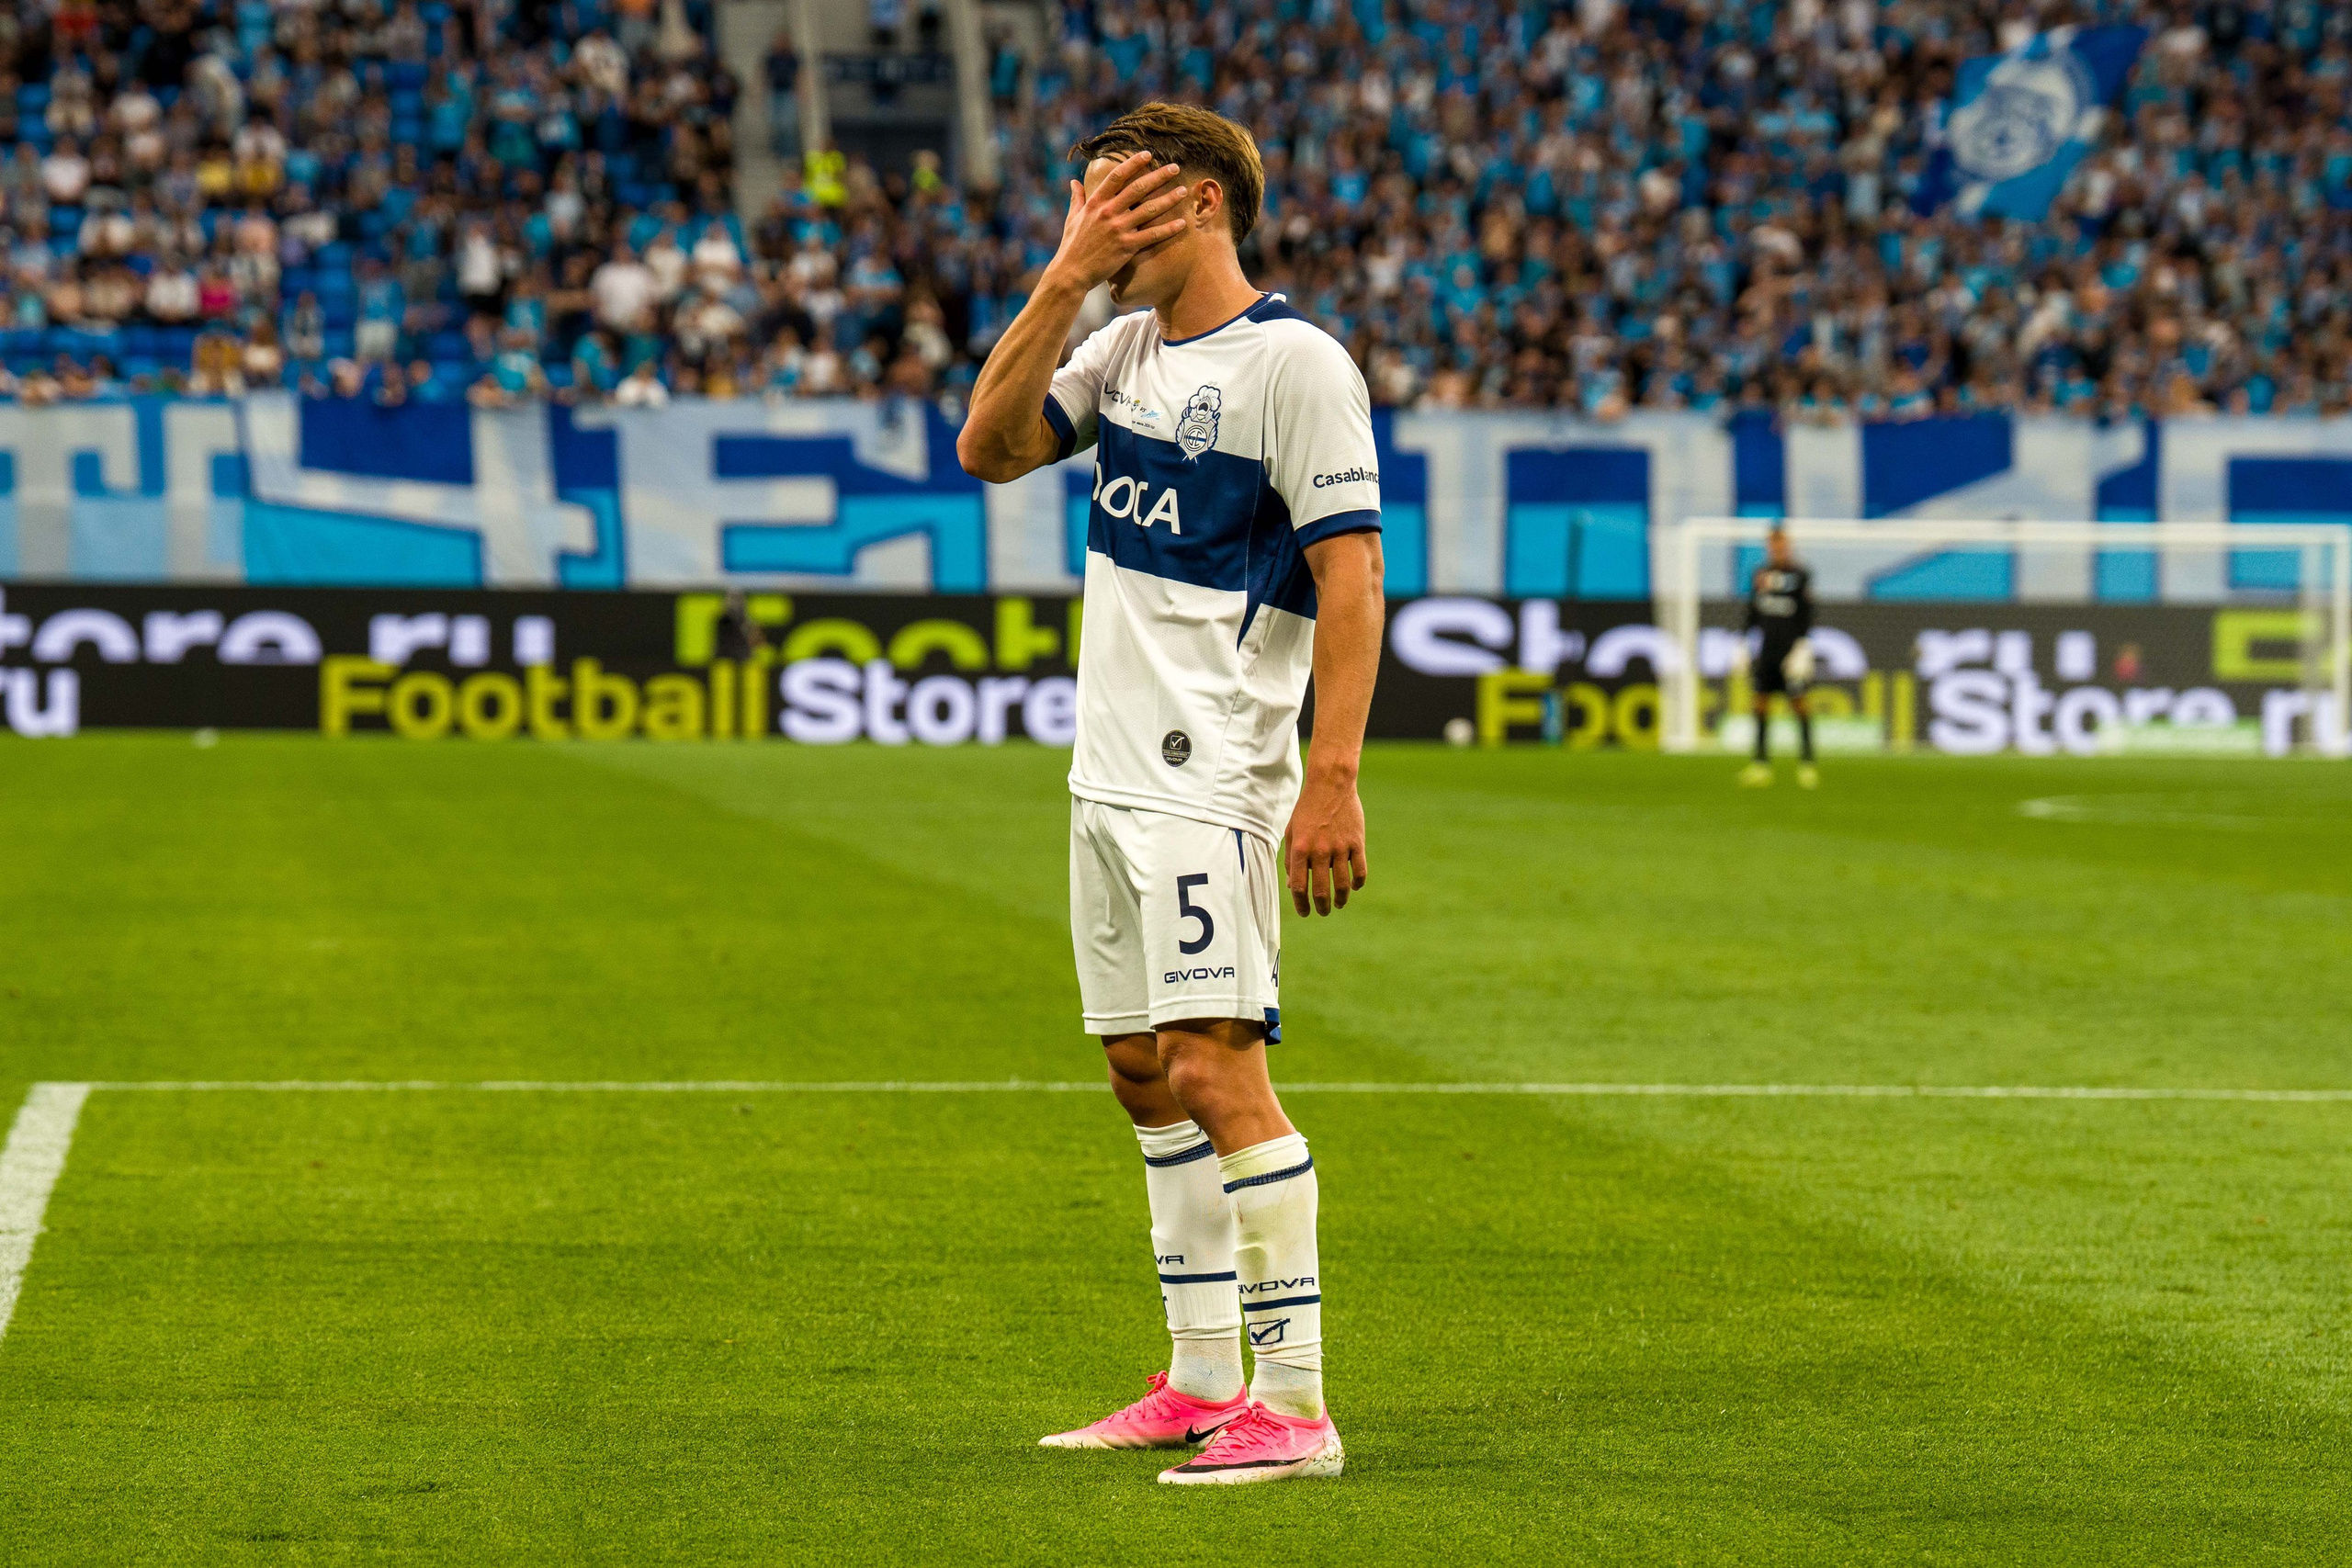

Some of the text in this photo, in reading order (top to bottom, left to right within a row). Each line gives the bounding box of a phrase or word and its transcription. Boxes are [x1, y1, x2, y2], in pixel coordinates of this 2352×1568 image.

[1313, 467, 1380, 489] Casablanc
[320, 654, 1078, 746] Football Store
[1176, 873, 1215, 955] 5
[1164, 966, 1235, 984] GIVOVA
[1238, 1276, 1315, 1294] IVOVA
